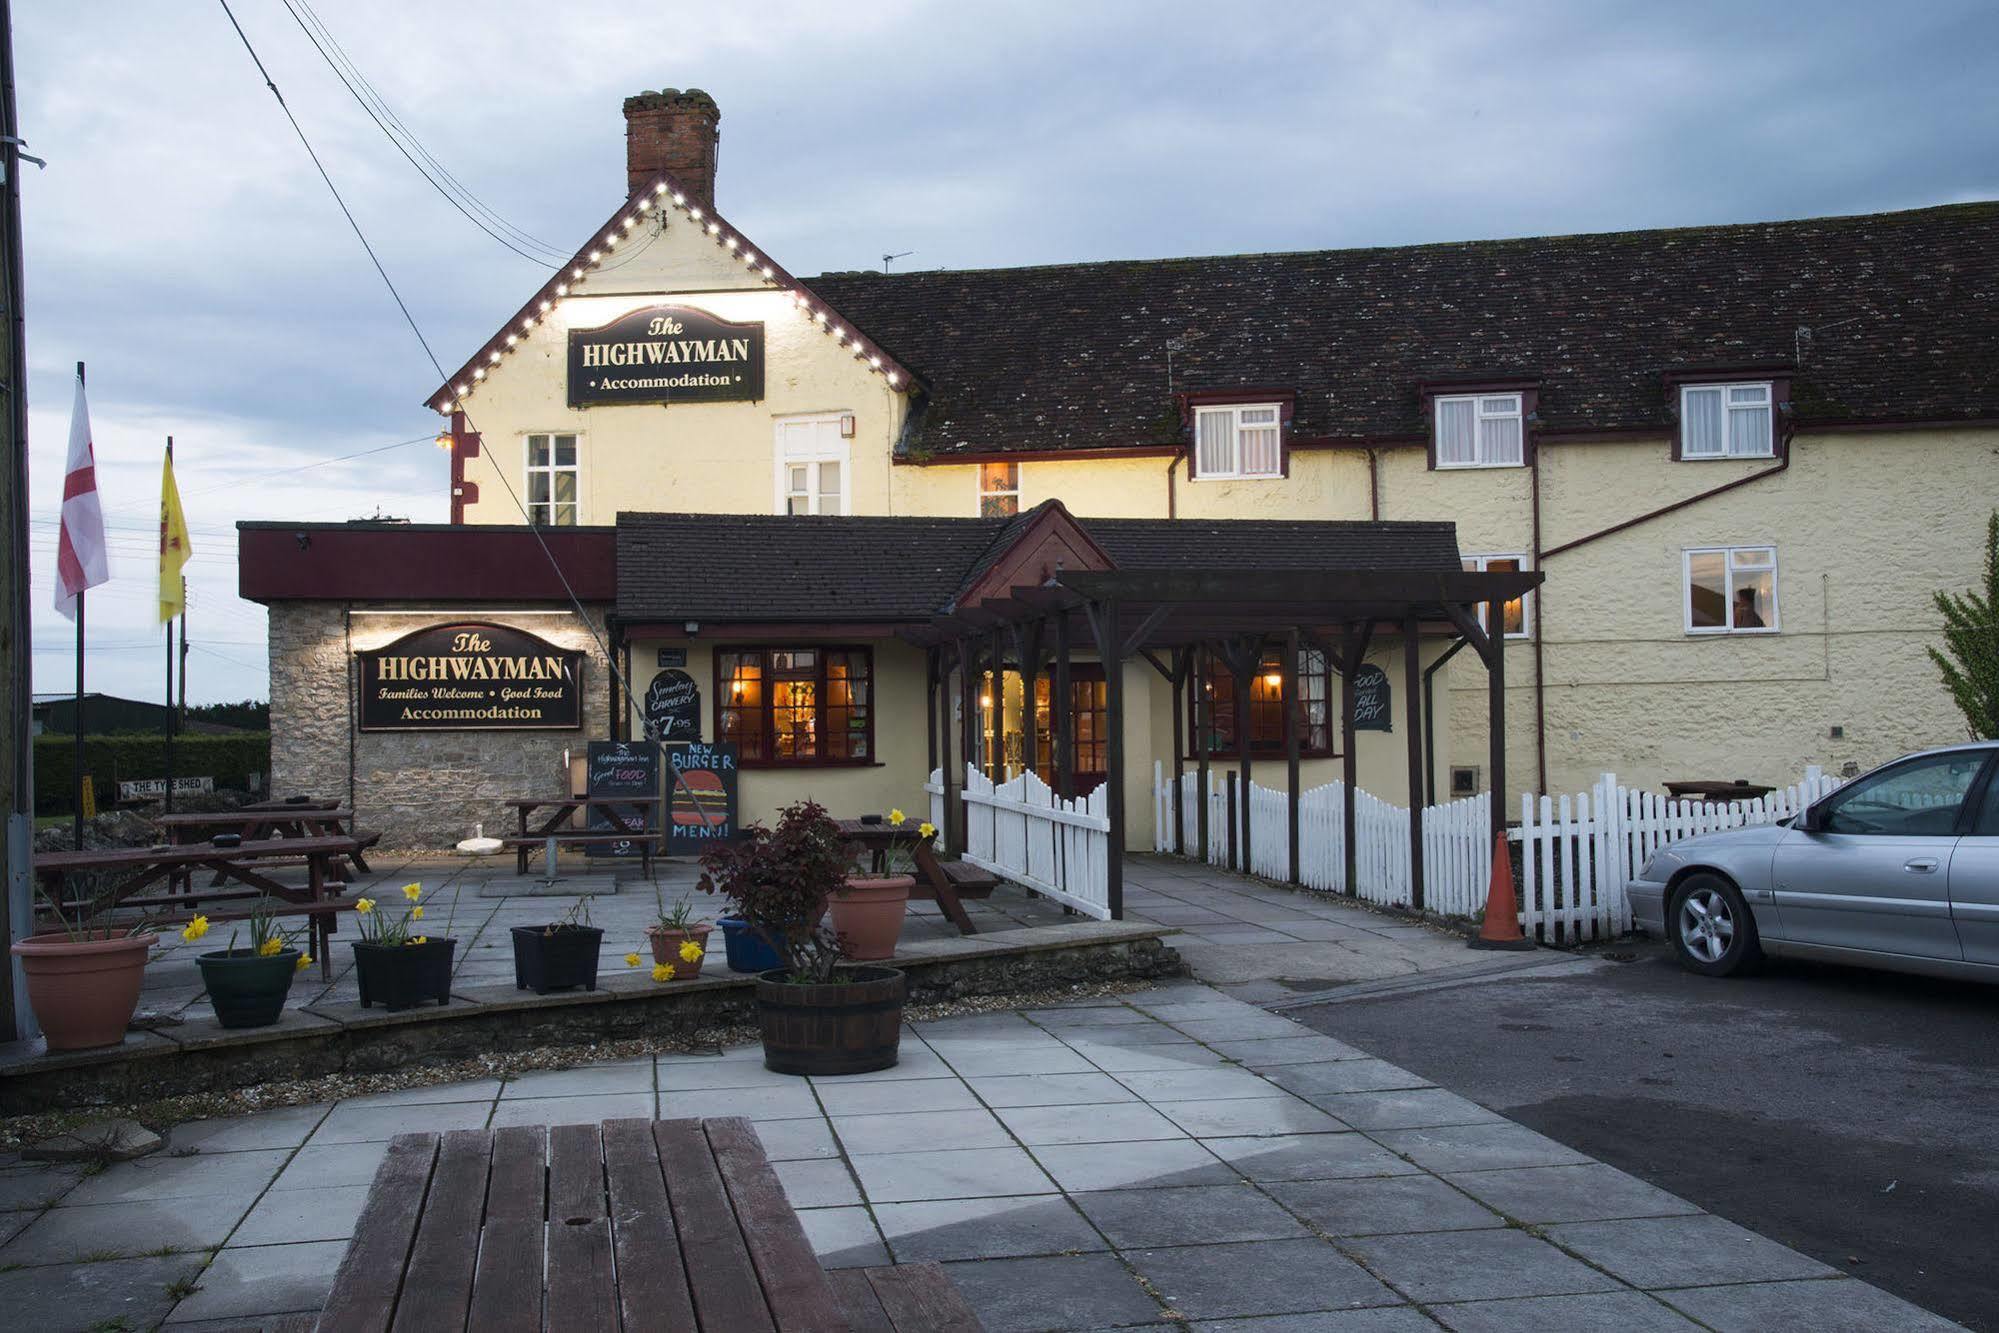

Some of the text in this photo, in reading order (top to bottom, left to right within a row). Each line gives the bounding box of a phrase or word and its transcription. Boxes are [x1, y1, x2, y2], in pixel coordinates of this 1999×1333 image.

[648, 317, 683, 336] The
[582, 338, 749, 367] HIGHWAYMAN
[600, 373, 730, 390] Accommodation
[452, 632, 491, 653] The
[377, 656, 564, 681] HIGHWAYMAN
[378, 687, 563, 701] Families Welcome Good Food
[1356, 694, 1378, 708] ALL
[651, 694, 695, 712] CARVERY
[400, 706, 542, 720] Accommodation
[1354, 703, 1385, 721] DAY
[689, 744, 713, 754] NEW
[671, 752, 734, 769] BURGER
[615, 770, 647, 781] FOOD
[134, 778, 201, 793] THE TYE SHED
